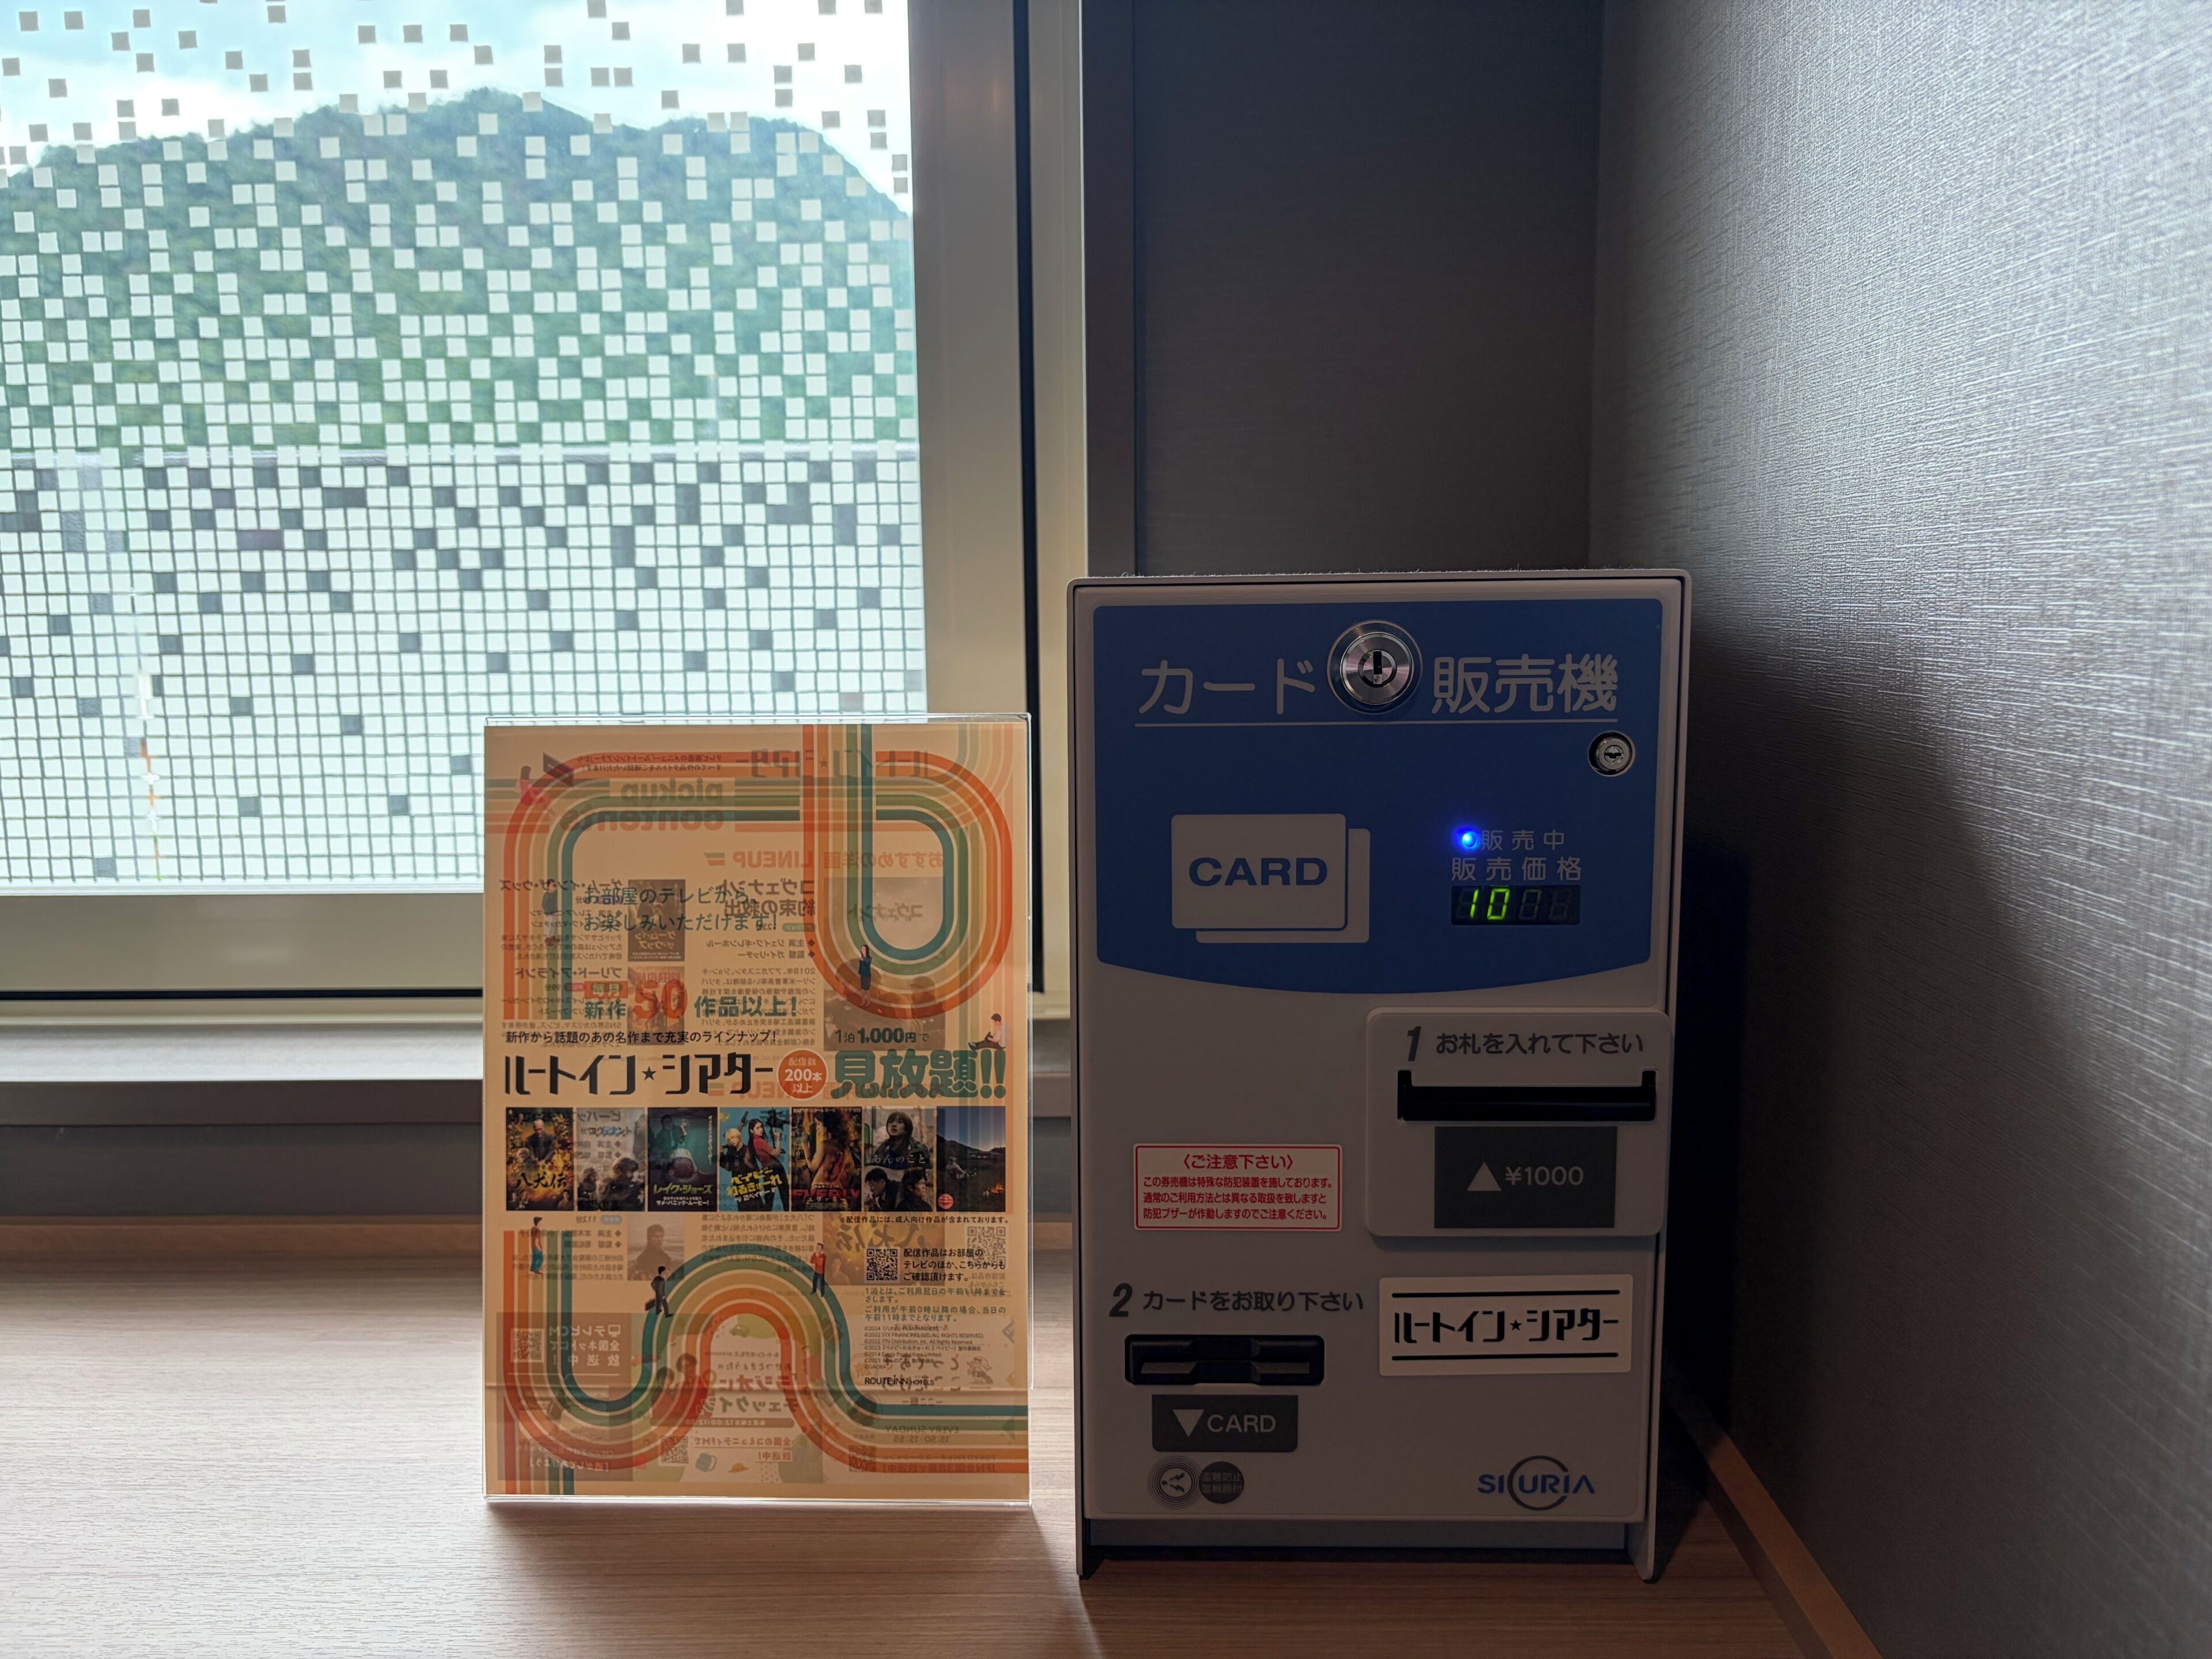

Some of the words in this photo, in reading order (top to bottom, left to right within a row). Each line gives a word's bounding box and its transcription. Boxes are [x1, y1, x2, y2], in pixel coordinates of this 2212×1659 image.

[1138, 659, 1316, 715] カード
[1432, 653, 1619, 714] 販売機
[1481, 830, 1565, 851] 販売中
[1189, 857, 1328, 887] CARD
[1451, 857, 1582, 881] 販売価格
[585, 999, 626, 1020] 新作
[634, 979, 688, 1019] 50
[694, 996, 797, 1017] 作品以上!
[506, 1031, 776, 1044] 新作から話題のあの名作まで充実のラインナップ!
[1407, 1026, 1421, 1062] 1
[1435, 1033, 1643, 1055] お札を入れて下さい
[785, 1069, 822, 1081] 200本
[793, 1083, 813, 1093] 以上
[1143, 1176, 1332, 1188] この券売機は特殊な防犯装置を施しております。
[1505, 1165, 1584, 1186] ¥1000
[1143, 1192, 1327, 1204] 通常のご利用方法とは異なる取扱を致しますと
[1143, 1209, 1327, 1220] 防犯ブザーが作動しますのでご注意ください。
[903, 1248, 984, 1257] 配信作品はお部屋の
[903, 1260, 1006, 1270] テレビのほか、こちらからも
[1109, 1283, 1133, 1317] 2
[1143, 1290, 1364, 1312] カードをお取り下さい
[1207, 1414, 1276, 1433] CARD
